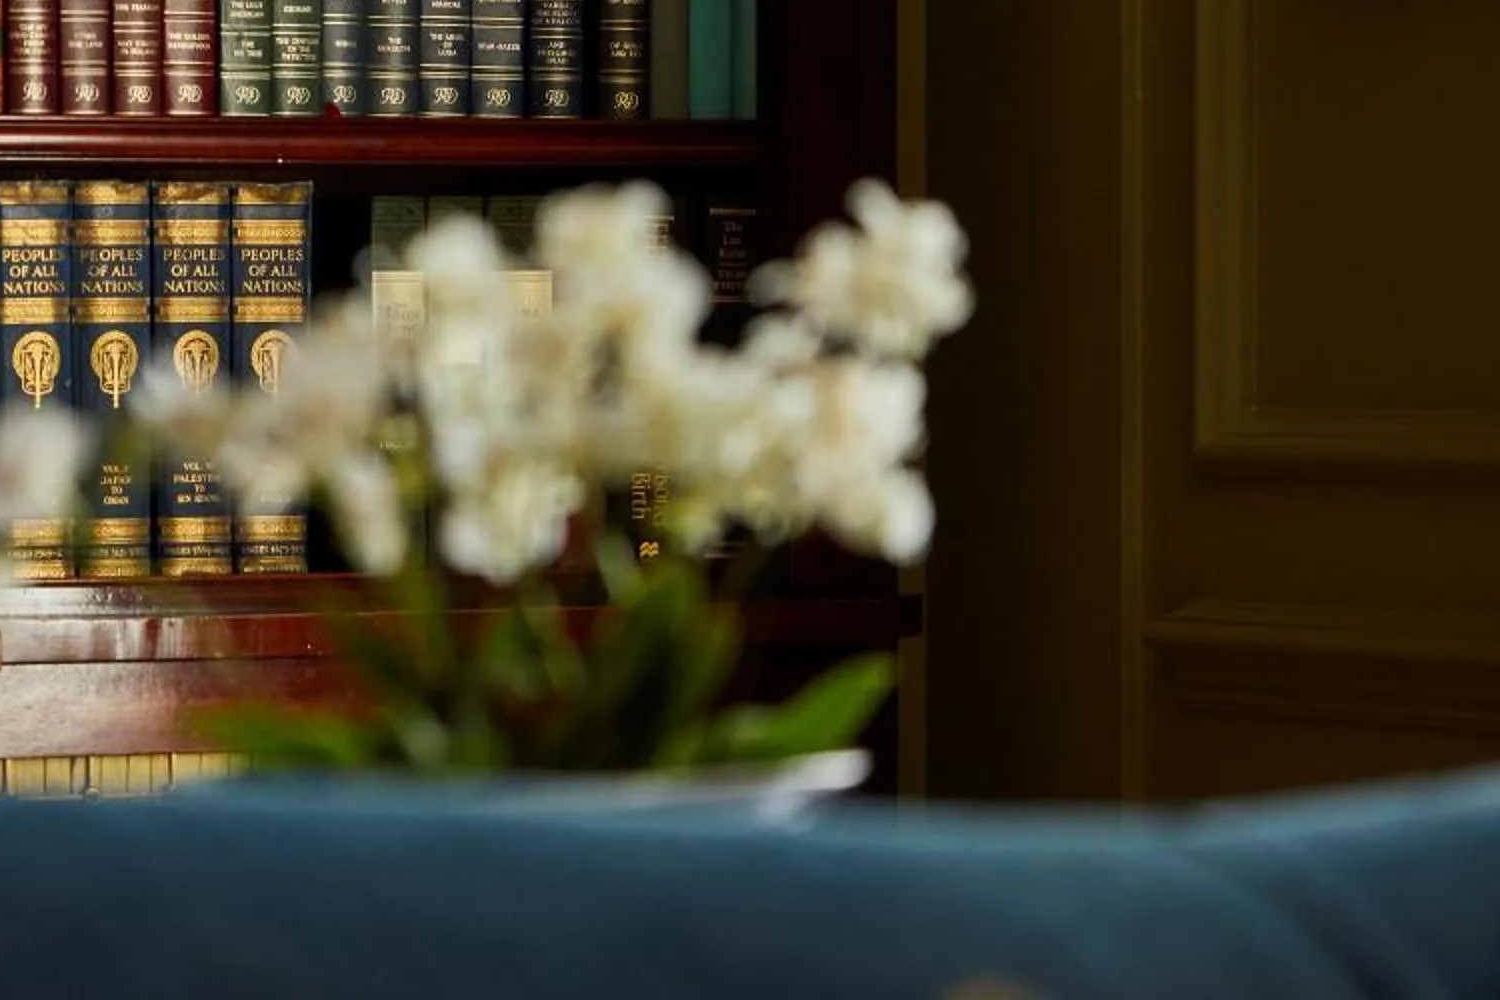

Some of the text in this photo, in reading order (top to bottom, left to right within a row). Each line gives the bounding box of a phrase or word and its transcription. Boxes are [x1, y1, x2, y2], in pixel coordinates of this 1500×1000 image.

[2, 249, 65, 262] PEOPLES
[80, 249, 144, 262] PEOPLES
[163, 248, 225, 261] PEOPLES
[241, 248, 304, 262] PEOPLES
[9, 265, 59, 278] OF ALL
[88, 265, 137, 278] OF ALL
[171, 264, 219, 277] OF ALL
[248, 264, 297, 277] OF ALL
[3, 281, 66, 294] NATIONS
[81, 281, 145, 294] NATIONS
[164, 280, 225, 293] NATIONS
[242, 280, 304, 293] NATIONS
[631, 472, 652, 520] Birth
